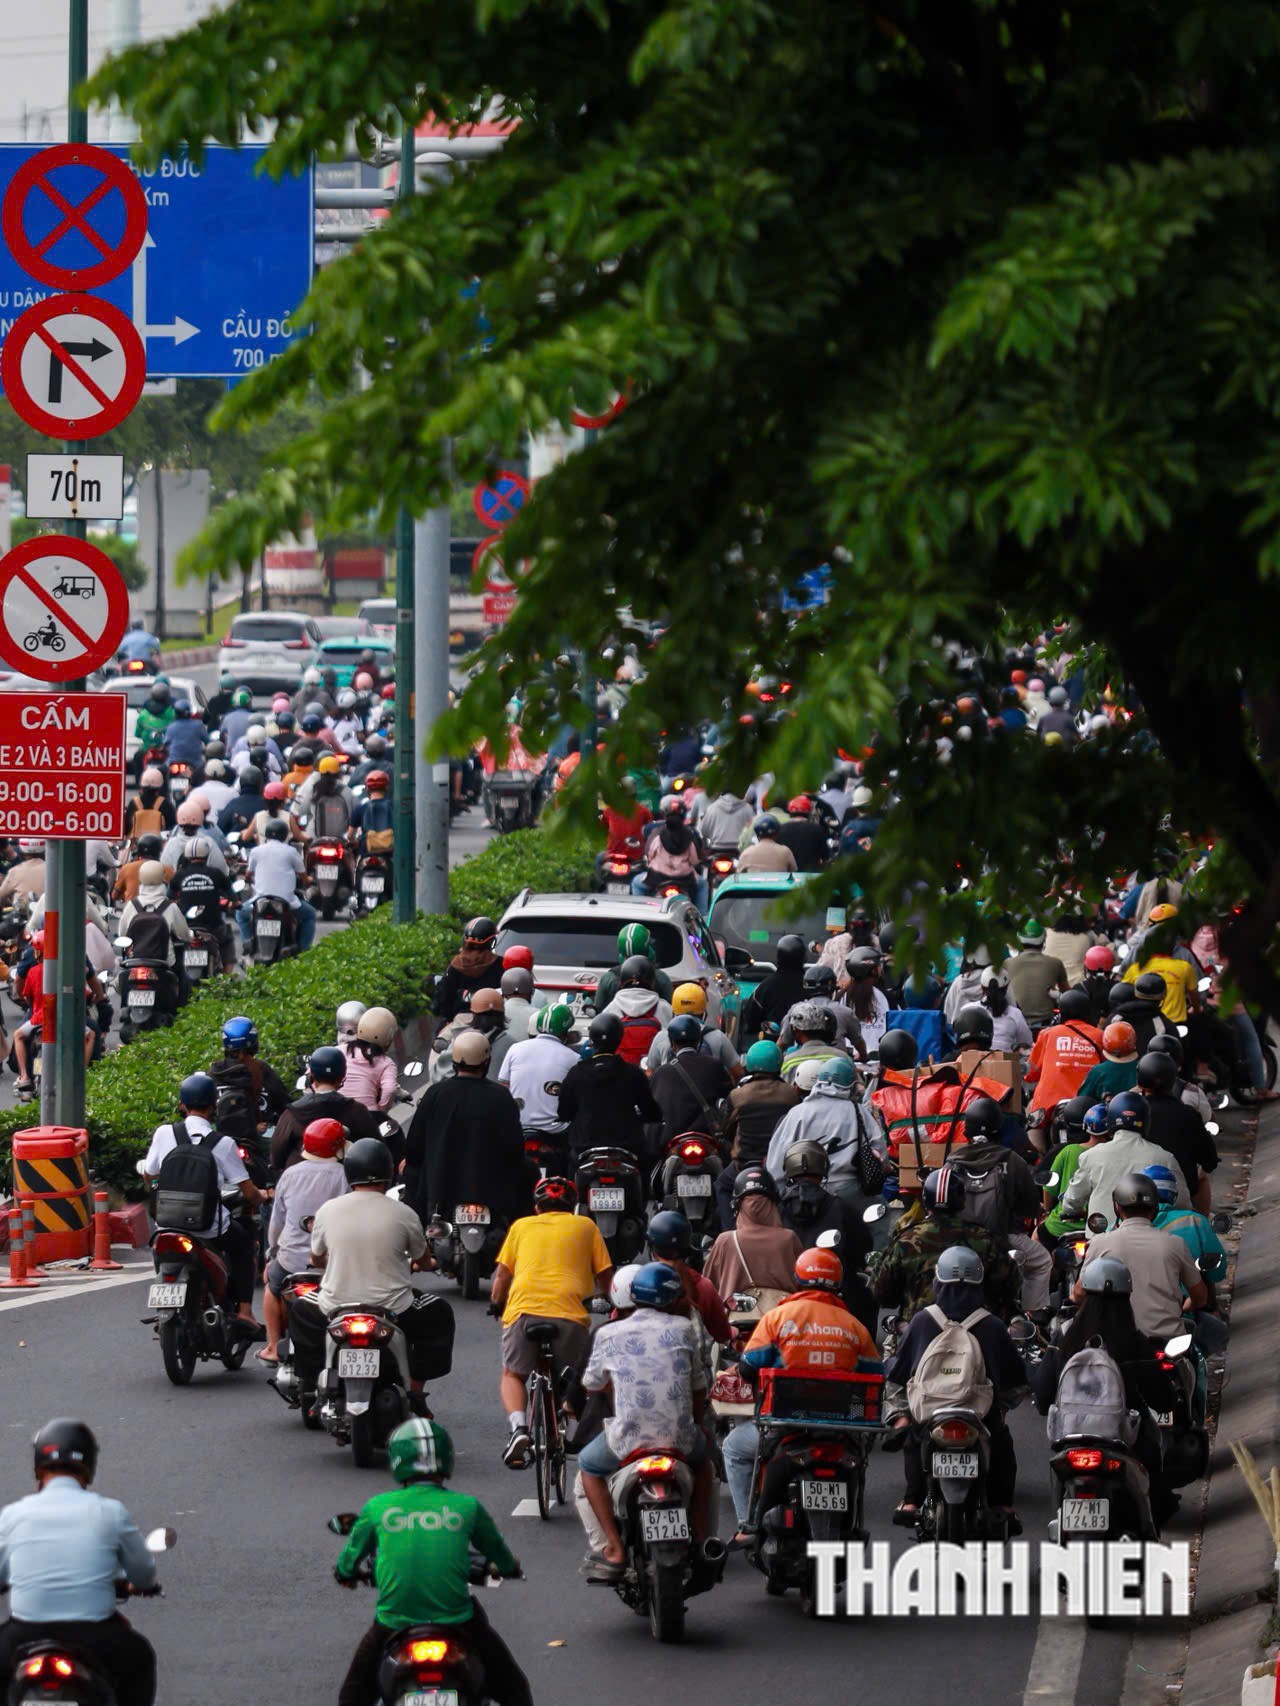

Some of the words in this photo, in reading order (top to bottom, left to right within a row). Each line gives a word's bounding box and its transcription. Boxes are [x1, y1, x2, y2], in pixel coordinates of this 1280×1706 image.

[13, 287, 46, 308] DÂN
[222, 309, 261, 338] CẦU
[233, 349, 264, 368] 700
[50, 470, 101, 502] 70m
[21, 697, 90, 731] CẤM
[14, 746, 24, 766] 2
[29, 739, 52, 766] VÀ
[56, 746, 65, 767] 3
[71, 740, 120, 768] BÁNH
[346, 1351, 375, 1362] 59-Y2
[341, 1364, 378, 1376] 812.32
[941, 1454, 971, 1465] 81-AD
[806, 1496, 846, 1510] 345.69
[382, 1506, 465, 1532] Grab
[649, 1511, 681, 1525] 67-G1
[1065, 1515, 1107, 1529] 124.83
[646, 1525, 687, 1540] 512.46
